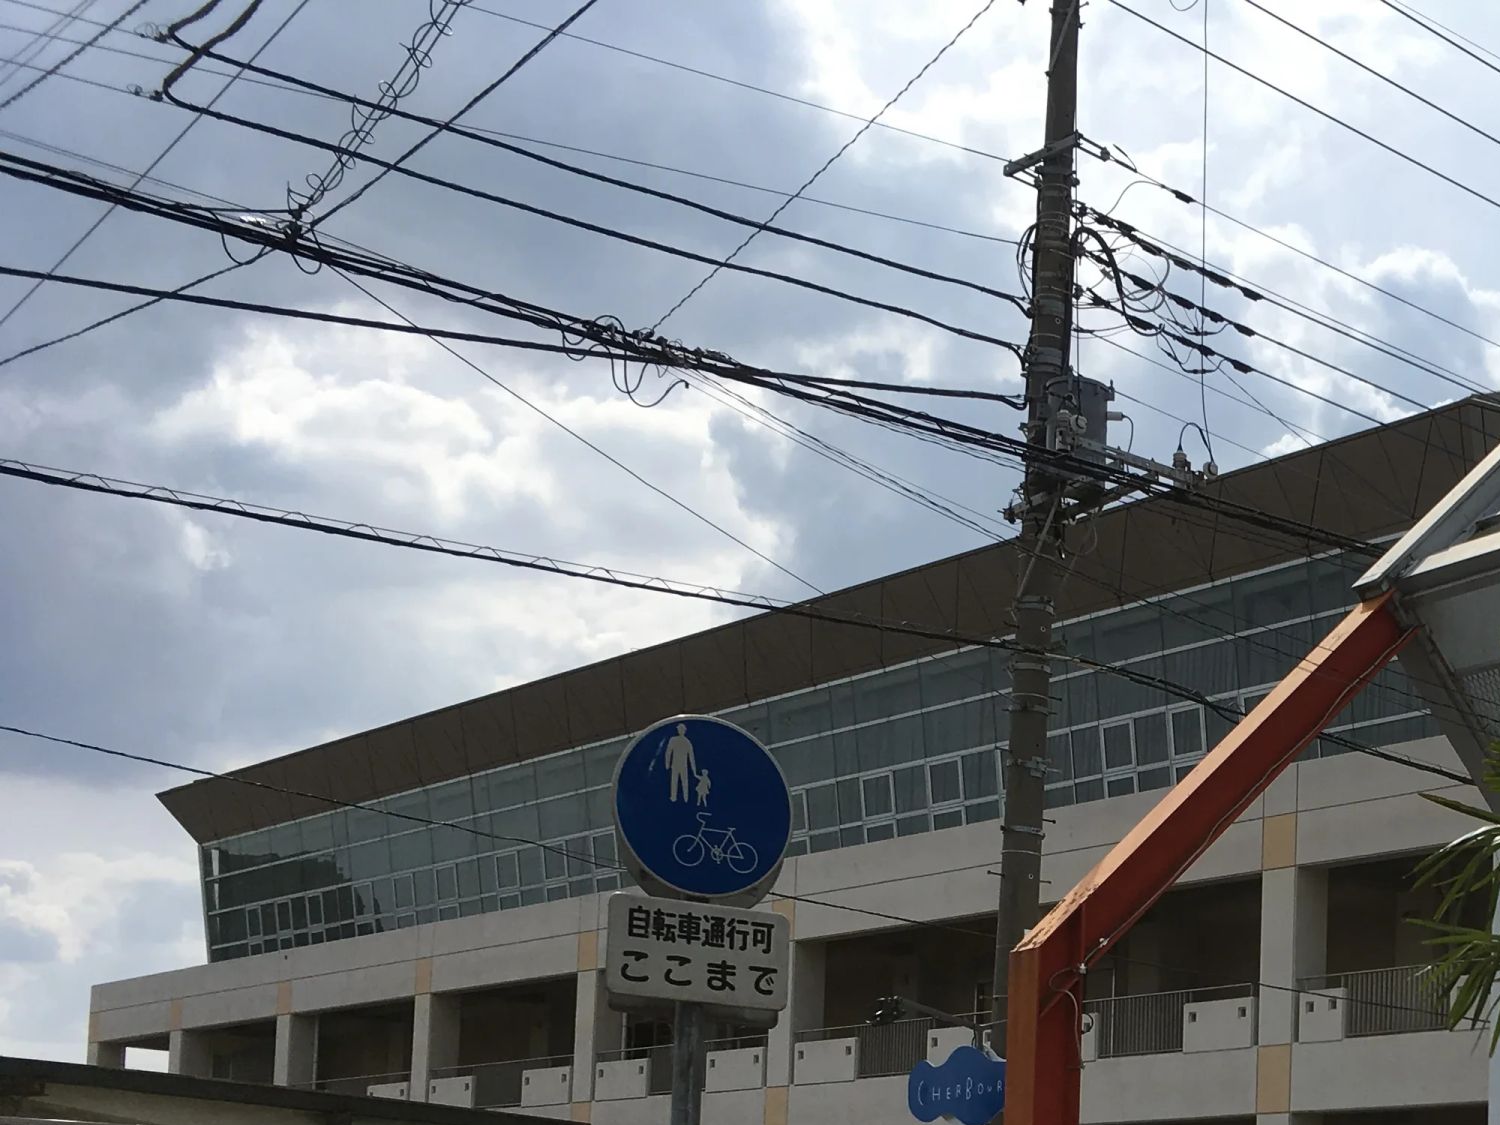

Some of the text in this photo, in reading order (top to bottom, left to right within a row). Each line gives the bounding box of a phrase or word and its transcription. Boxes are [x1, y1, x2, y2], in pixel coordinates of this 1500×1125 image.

[628, 905, 775, 954] 自転車通行可
[621, 950, 778, 995] ここまで
